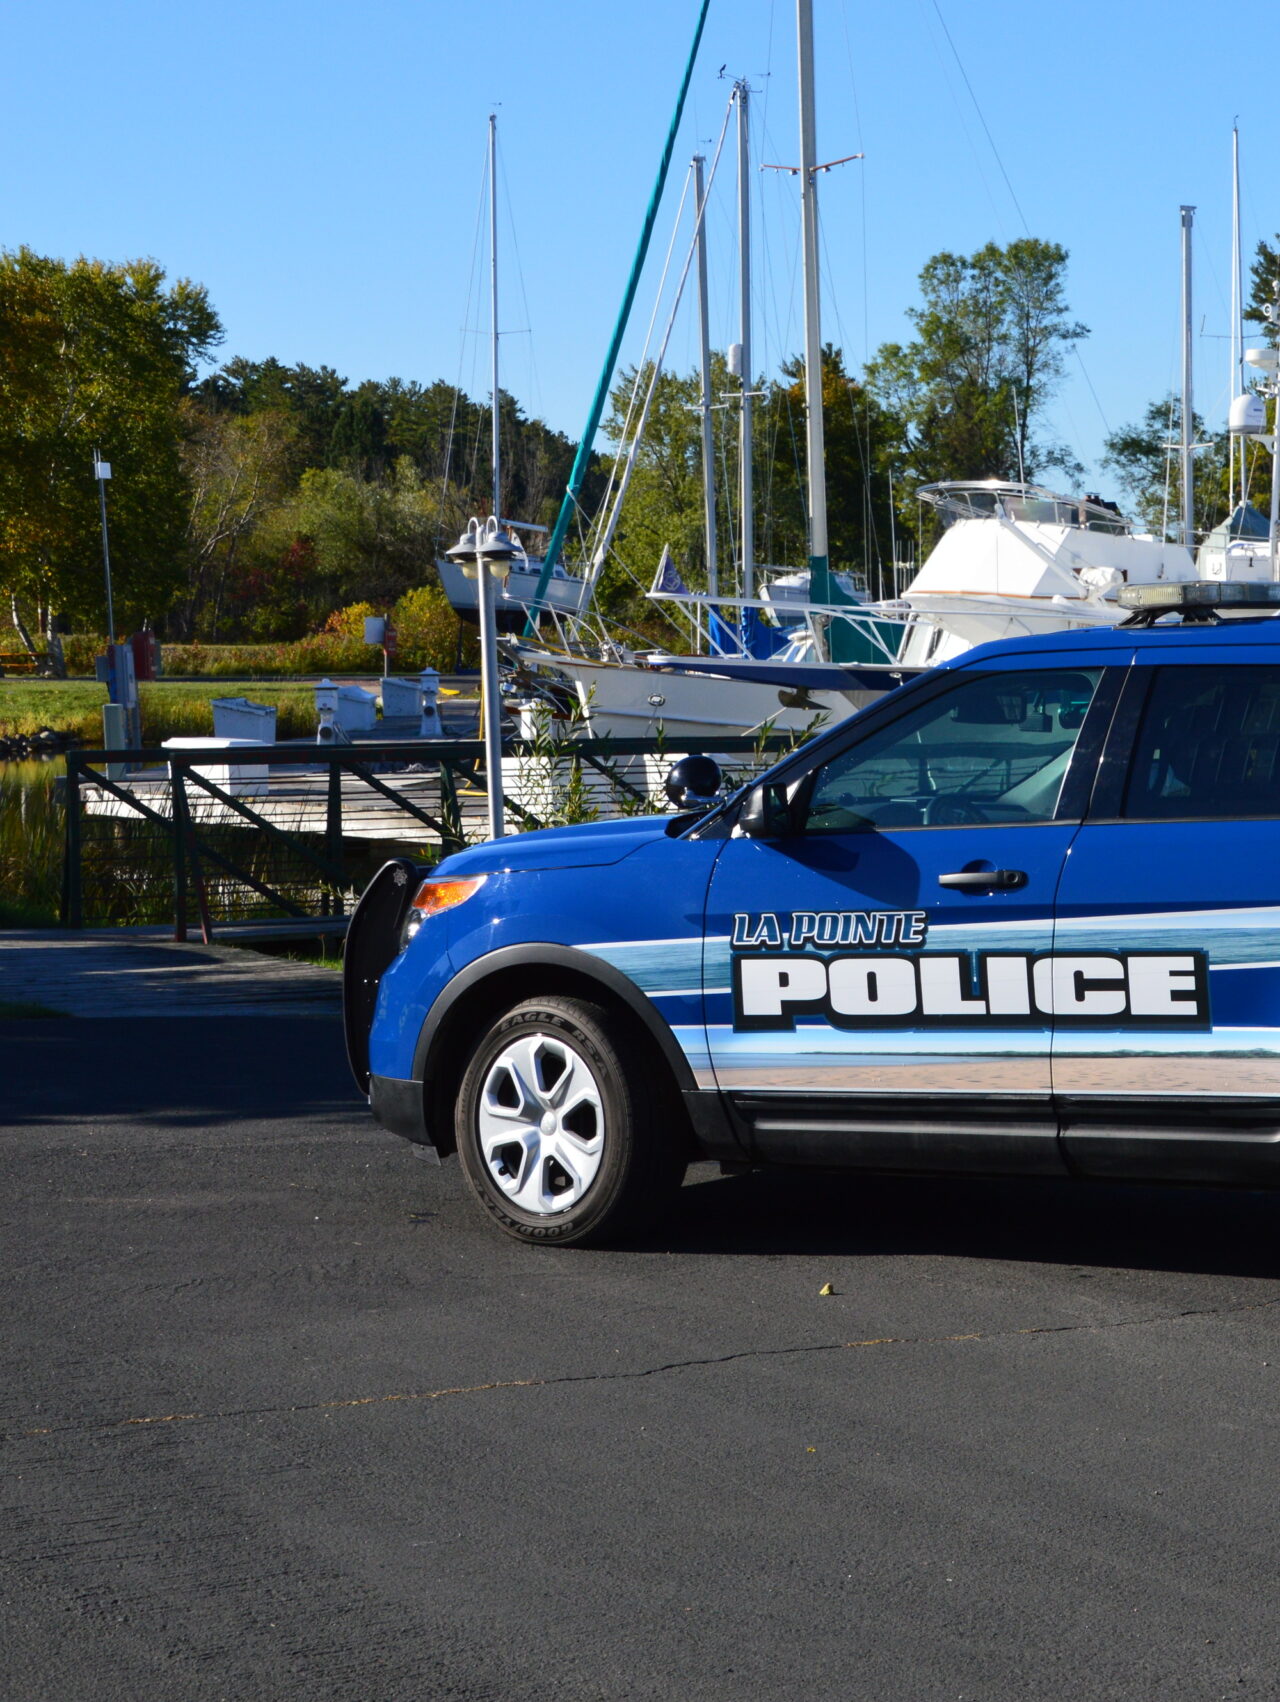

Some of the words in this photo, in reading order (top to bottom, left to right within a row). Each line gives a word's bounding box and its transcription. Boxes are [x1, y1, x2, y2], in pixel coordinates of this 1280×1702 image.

[732, 912, 783, 947] LA
[790, 910, 928, 946] POINTE
[738, 954, 1200, 1018] POLICE
[500, 1011, 566, 1032] EAGLE
